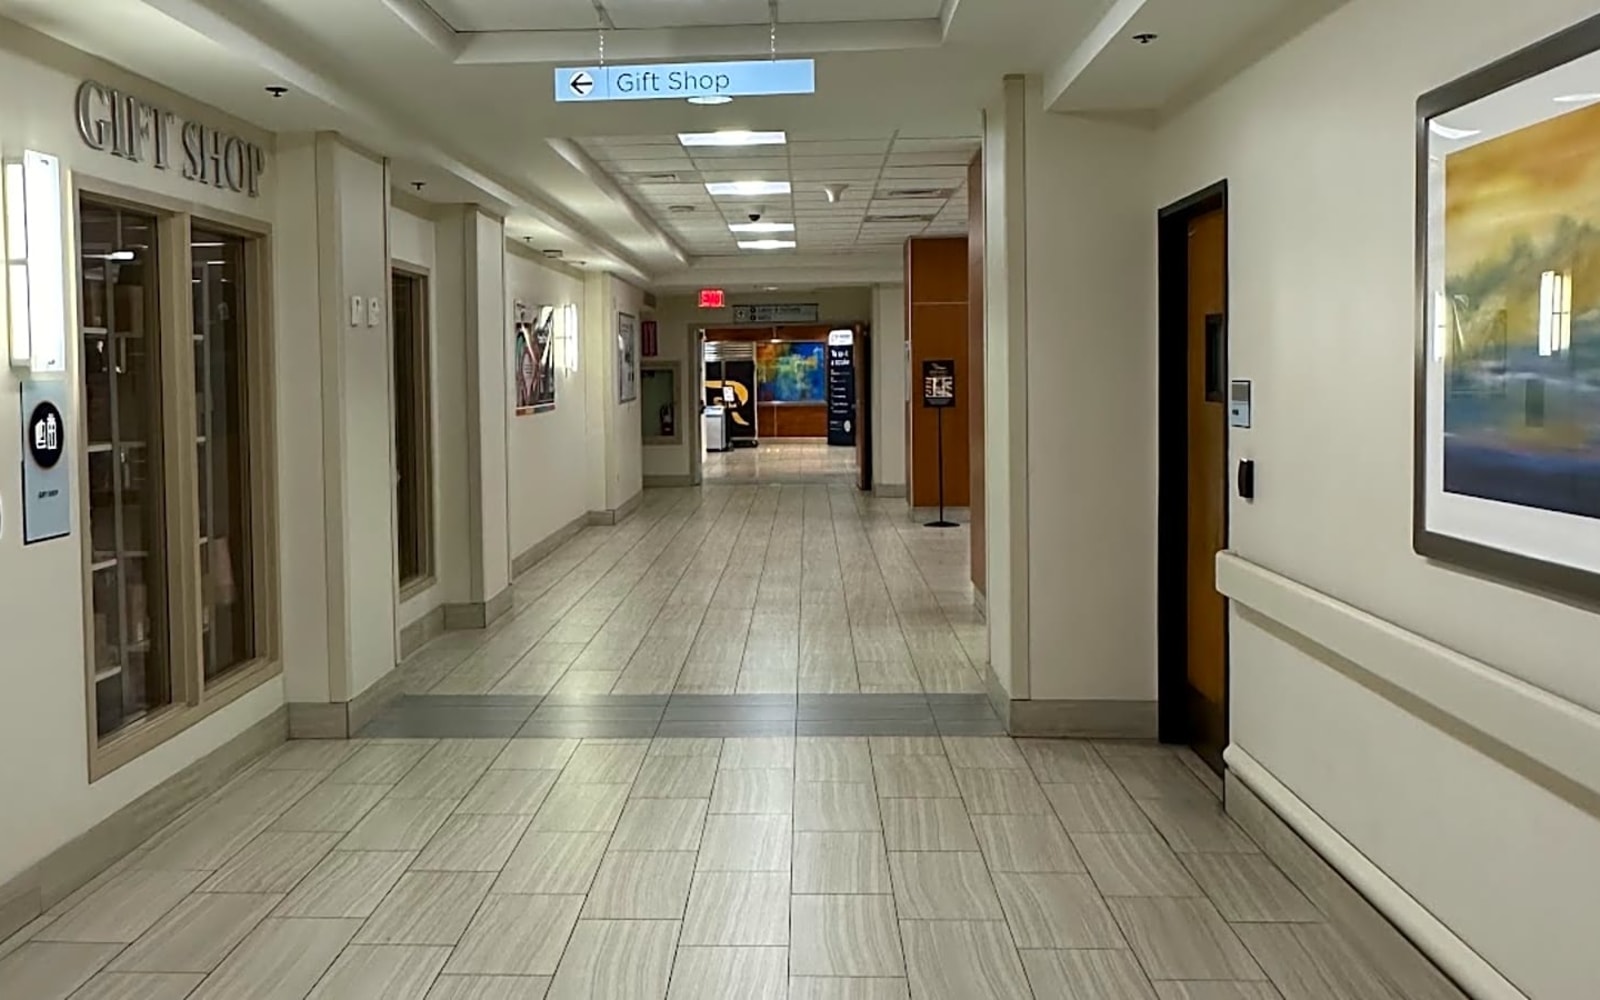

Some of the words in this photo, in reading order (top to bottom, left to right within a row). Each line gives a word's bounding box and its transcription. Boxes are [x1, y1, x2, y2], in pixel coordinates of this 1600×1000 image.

[616, 72, 660, 93] Gift
[668, 71, 730, 93] Shop
[75, 80, 175, 169] GIFT
[182, 121, 265, 198] SHOP
